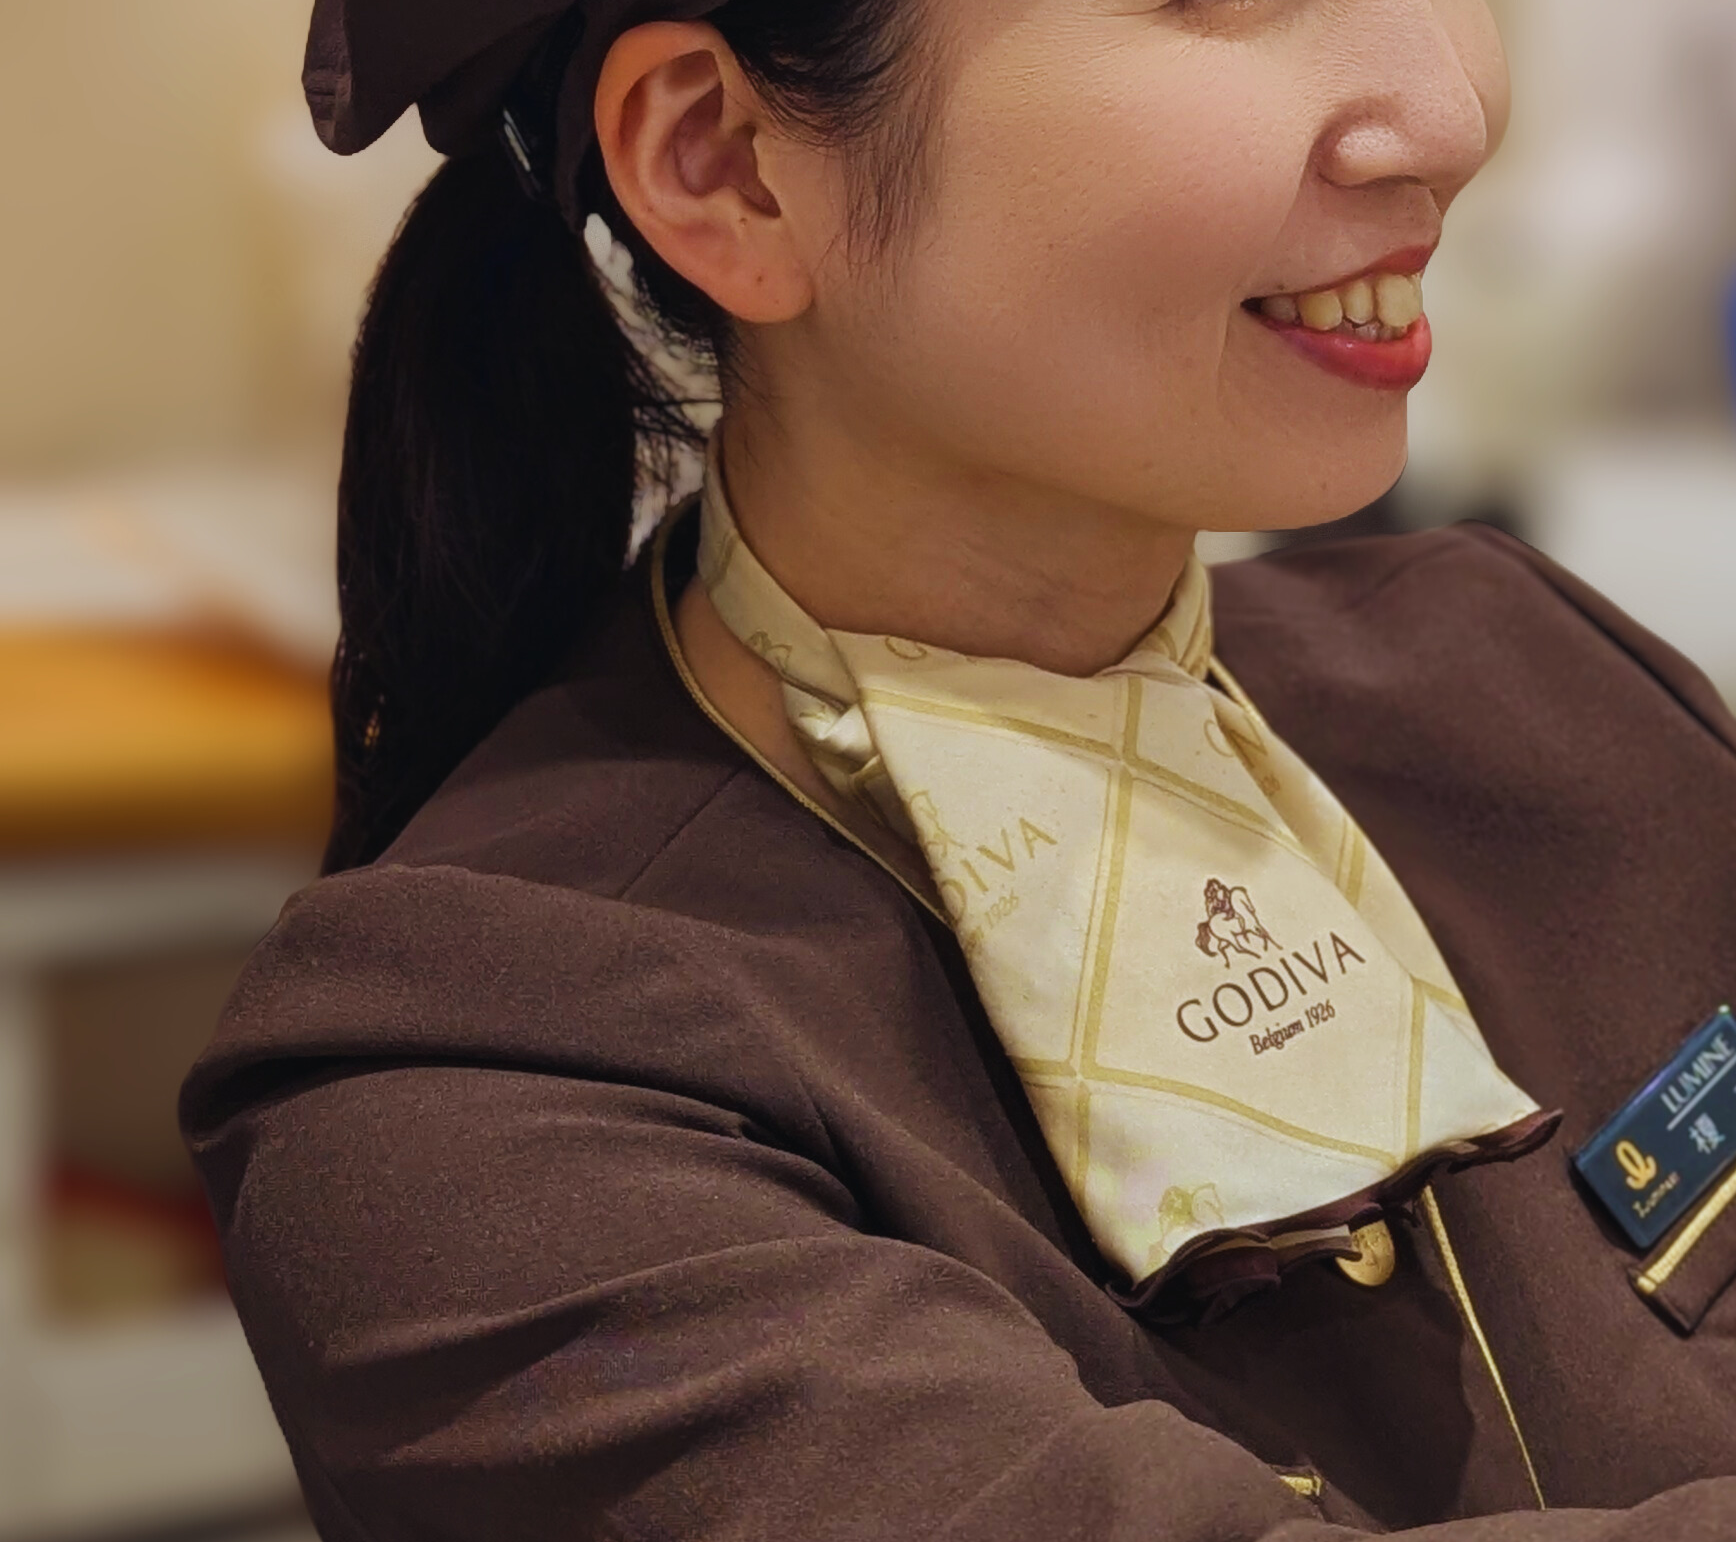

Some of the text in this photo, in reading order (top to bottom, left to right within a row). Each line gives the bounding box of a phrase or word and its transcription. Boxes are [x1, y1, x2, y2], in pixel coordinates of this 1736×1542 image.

[940, 817, 1057, 926] DIVA
[1177, 931, 1366, 1043] GODIVA
[1249, 999, 1336, 1055] Belgium 1926
[1660, 1033, 1735, 1114] LUMINE
